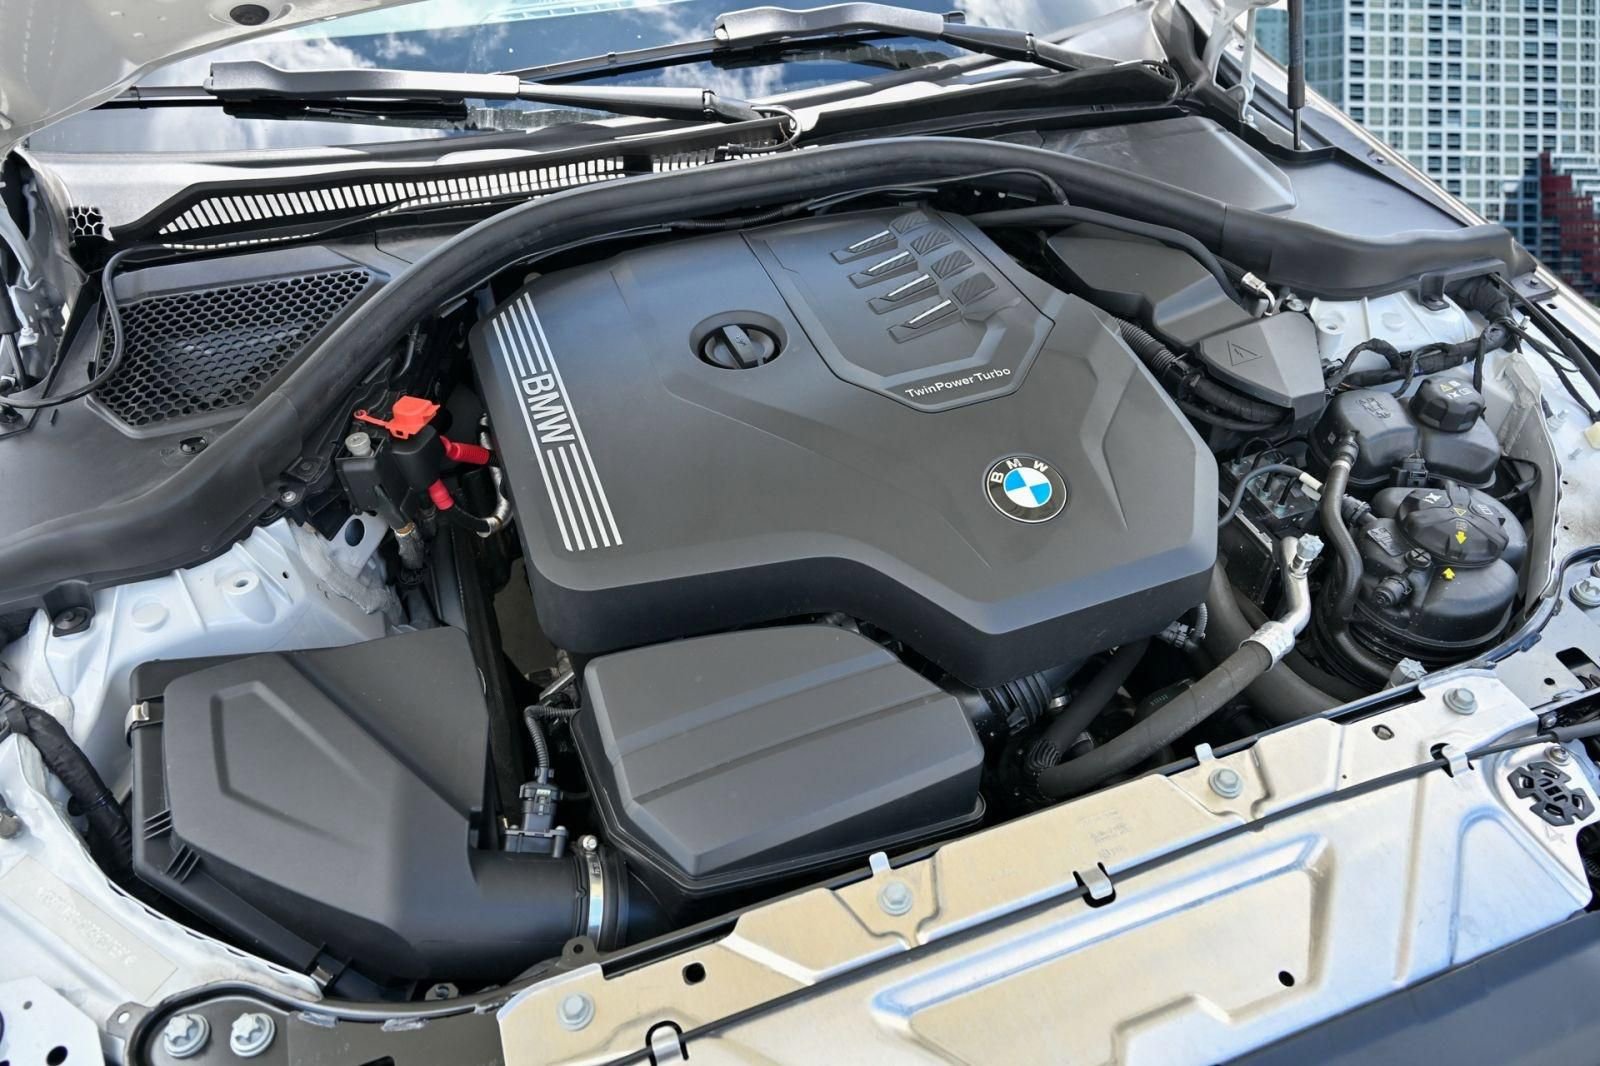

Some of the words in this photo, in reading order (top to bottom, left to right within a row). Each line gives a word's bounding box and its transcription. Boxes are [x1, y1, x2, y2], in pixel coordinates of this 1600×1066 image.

[905, 377, 974, 398] TwinPower
[973, 367, 1011, 382] Turbo
[521, 373, 576, 444] BMW
[990, 458, 1049, 484] BMW
